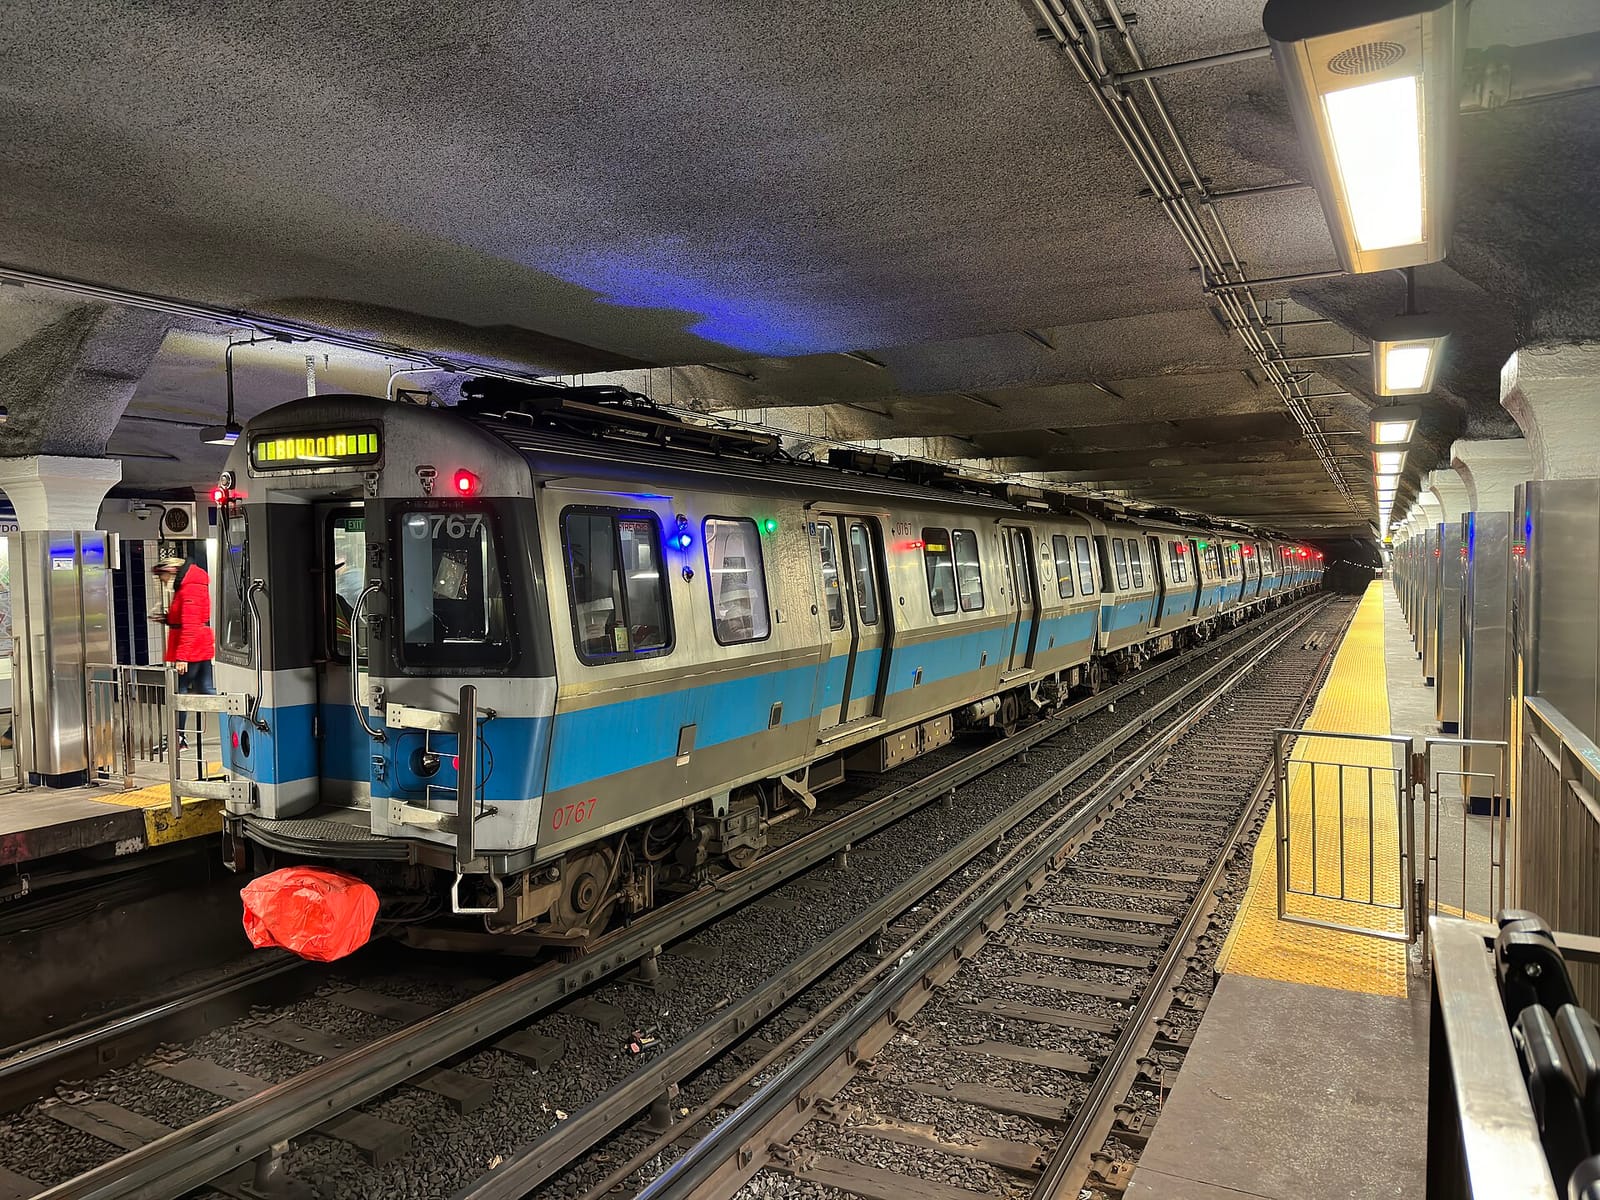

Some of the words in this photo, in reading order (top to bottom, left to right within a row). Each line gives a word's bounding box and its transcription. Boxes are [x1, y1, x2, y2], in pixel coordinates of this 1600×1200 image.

[0, 524, 19, 533] DO
[408, 513, 483, 540] 0767
[896, 521, 912, 537] 0767
[552, 797, 598, 831] 0767
